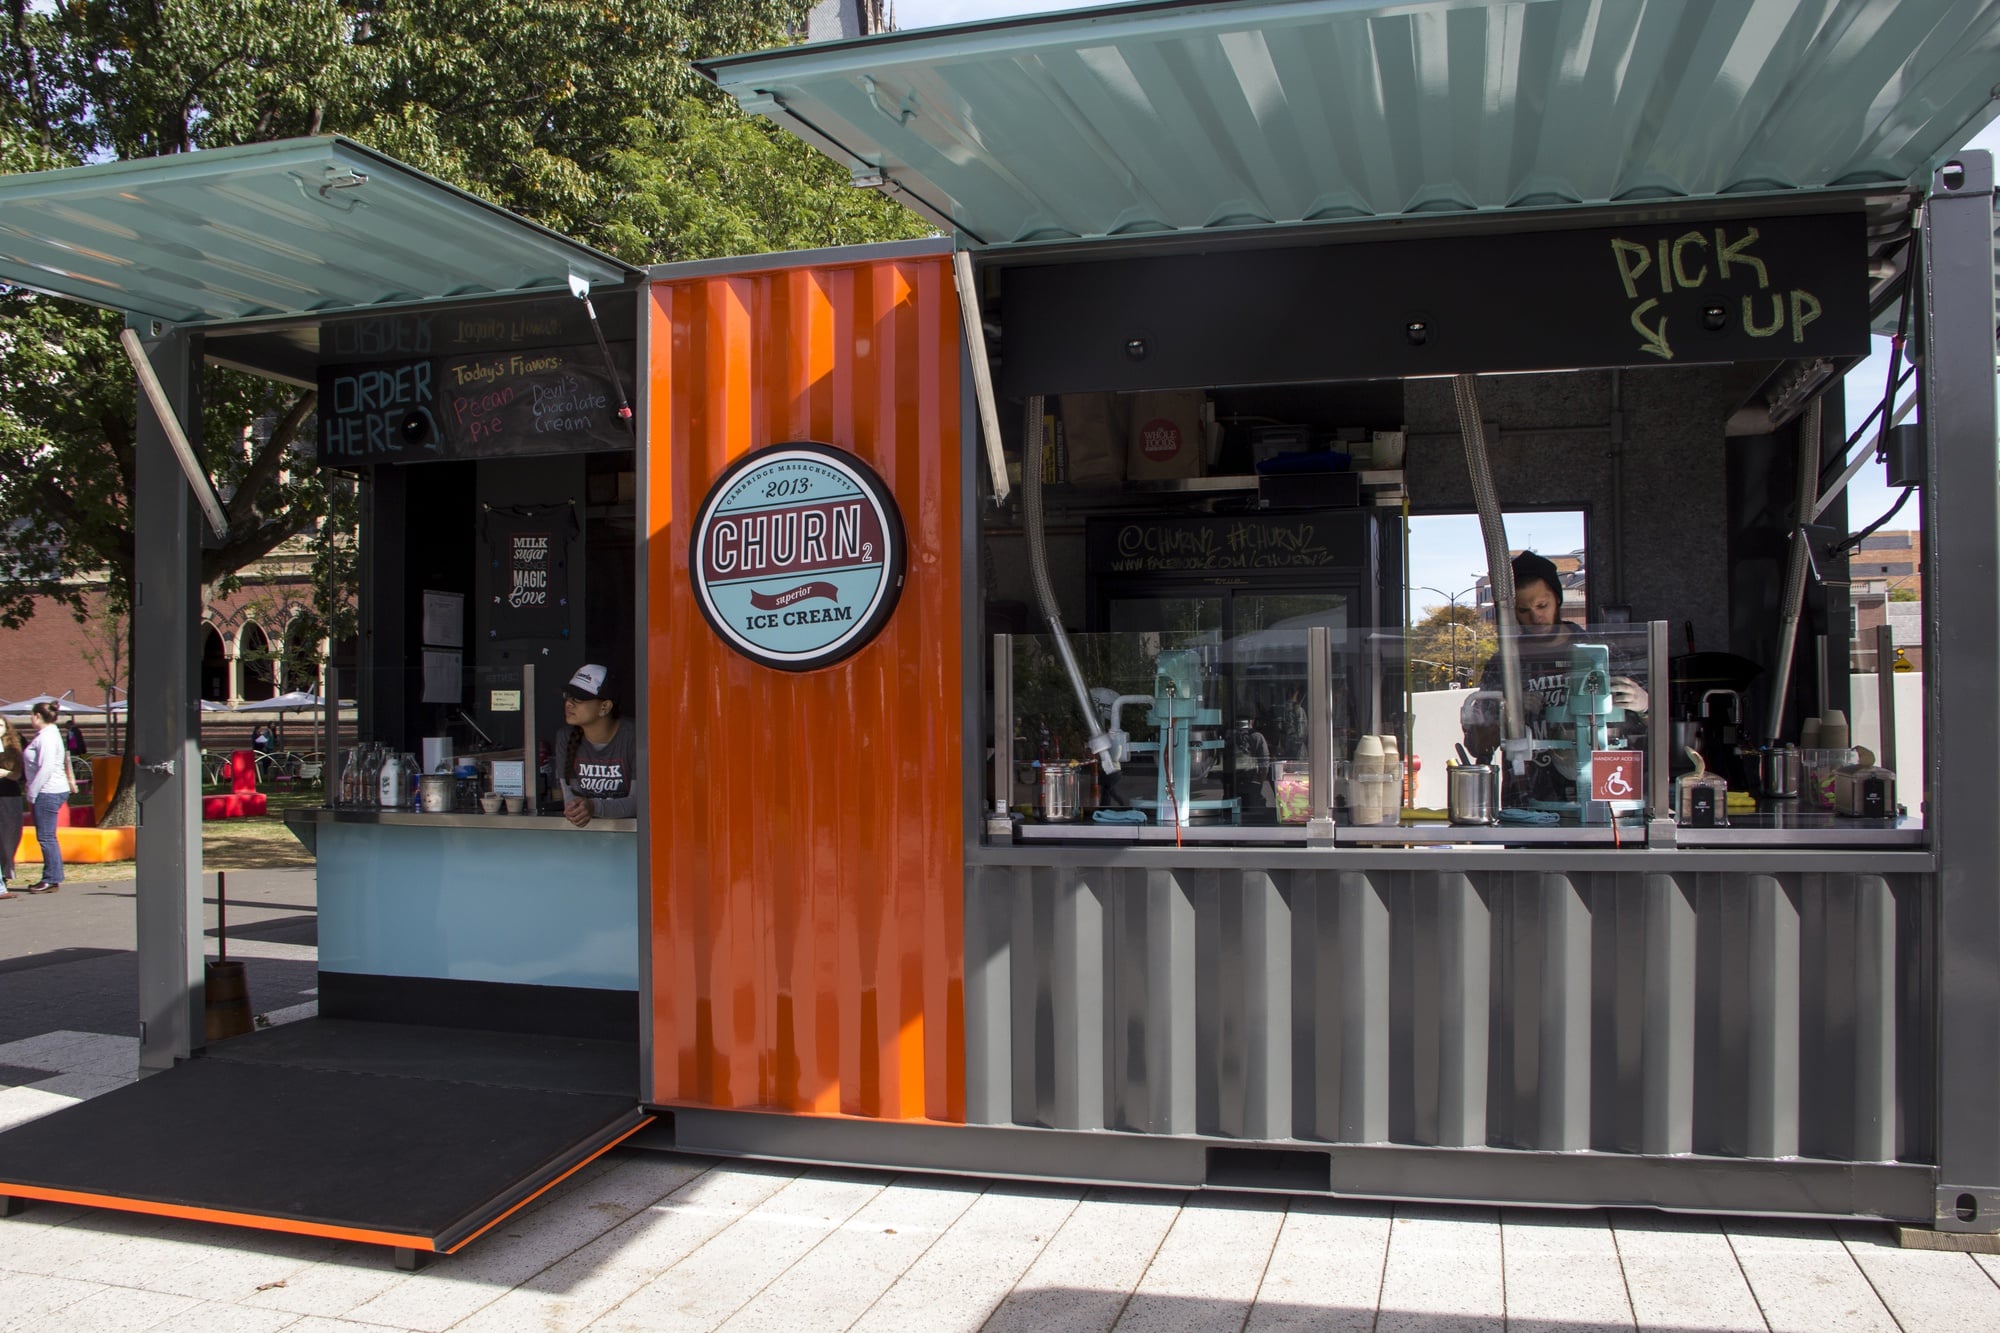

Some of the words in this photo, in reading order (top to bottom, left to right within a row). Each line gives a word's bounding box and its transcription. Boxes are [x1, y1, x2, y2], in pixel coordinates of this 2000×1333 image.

[1611, 226, 1769, 299] PICK
[1742, 288, 1822, 343] UP
[452, 364, 505, 386] Today's
[510, 355, 563, 377] Flavors:
[334, 361, 432, 414] ORDER
[533, 375, 578, 402] Devil's
[453, 386, 514, 424] Pecan
[533, 393, 607, 417] Chocolate
[326, 409, 404, 455] HERE
[470, 416, 503, 442] Pie
[535, 413, 592, 433] Cream
[1144, 431, 1177, 441] WHOLE
[726, 468, 774, 505] CAMBRIDGE
[778, 464, 852, 491] MASSACHUSETTS
[513, 537, 548, 548] MILK
[1117, 525, 1222, 557] @CHURN2
[1226, 522, 1328, 554] #CHURN2
[513, 549, 547, 562] sugar
[513, 570, 546, 588] MAGIC
[508, 586, 546, 608] Love
[775, 585, 812, 606] superior
[746, 614, 779, 630] ICE
[783, 606, 853, 627] CREAM
[579, 764, 622, 777] MILK
[580, 777, 623, 793] sugar
